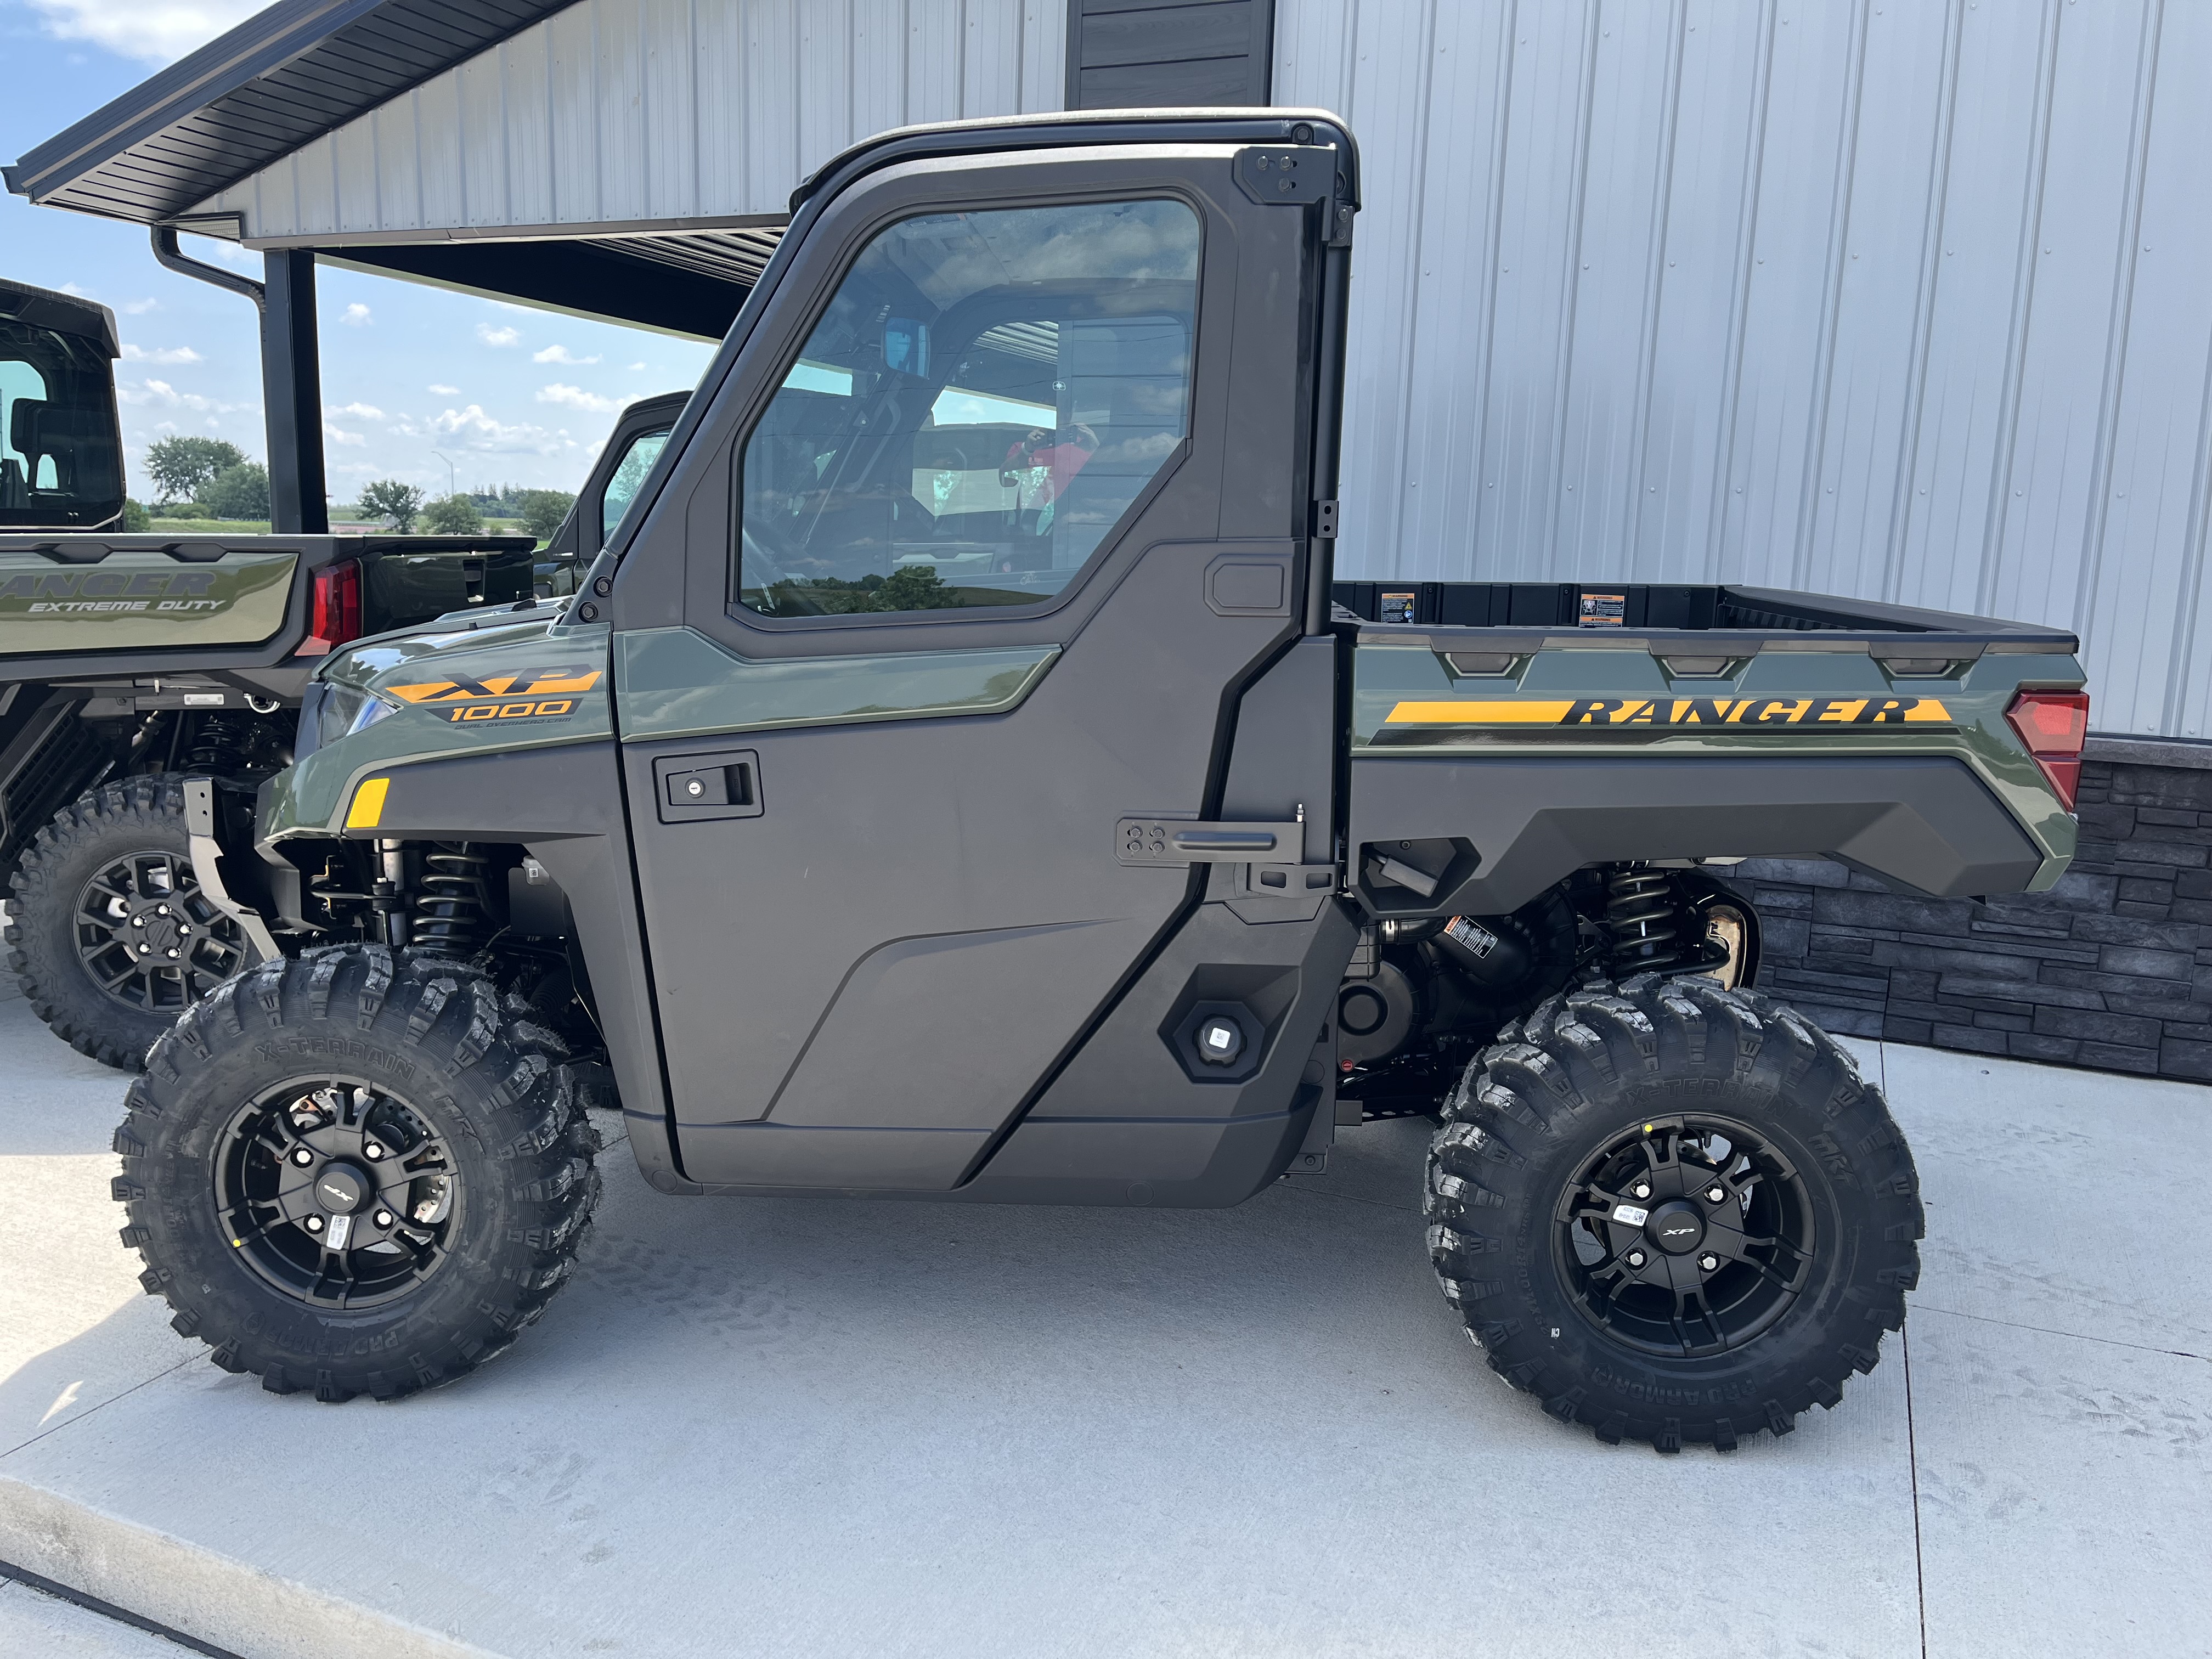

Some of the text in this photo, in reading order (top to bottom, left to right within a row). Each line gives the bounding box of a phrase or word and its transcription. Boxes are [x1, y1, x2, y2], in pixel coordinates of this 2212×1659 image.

[0, 571, 216, 599] ANGER
[28, 600, 227, 612] EXTREME DUTY
[419, 664, 594, 700] XP
[450, 700, 572, 722] 1000
[486, 719, 545, 728] OVERHEAD
[1559, 697, 1920, 726] RANGER
[254, 1035, 416, 1081] X-TERRAIN
[1626, 1077, 1794, 1119] X-TERRAIN
[1662, 1227, 1695, 1237] XP
[263, 1327, 399, 1357] PRO ARMOR
[1613, 1375, 1757, 1407] PRO ARMOR
